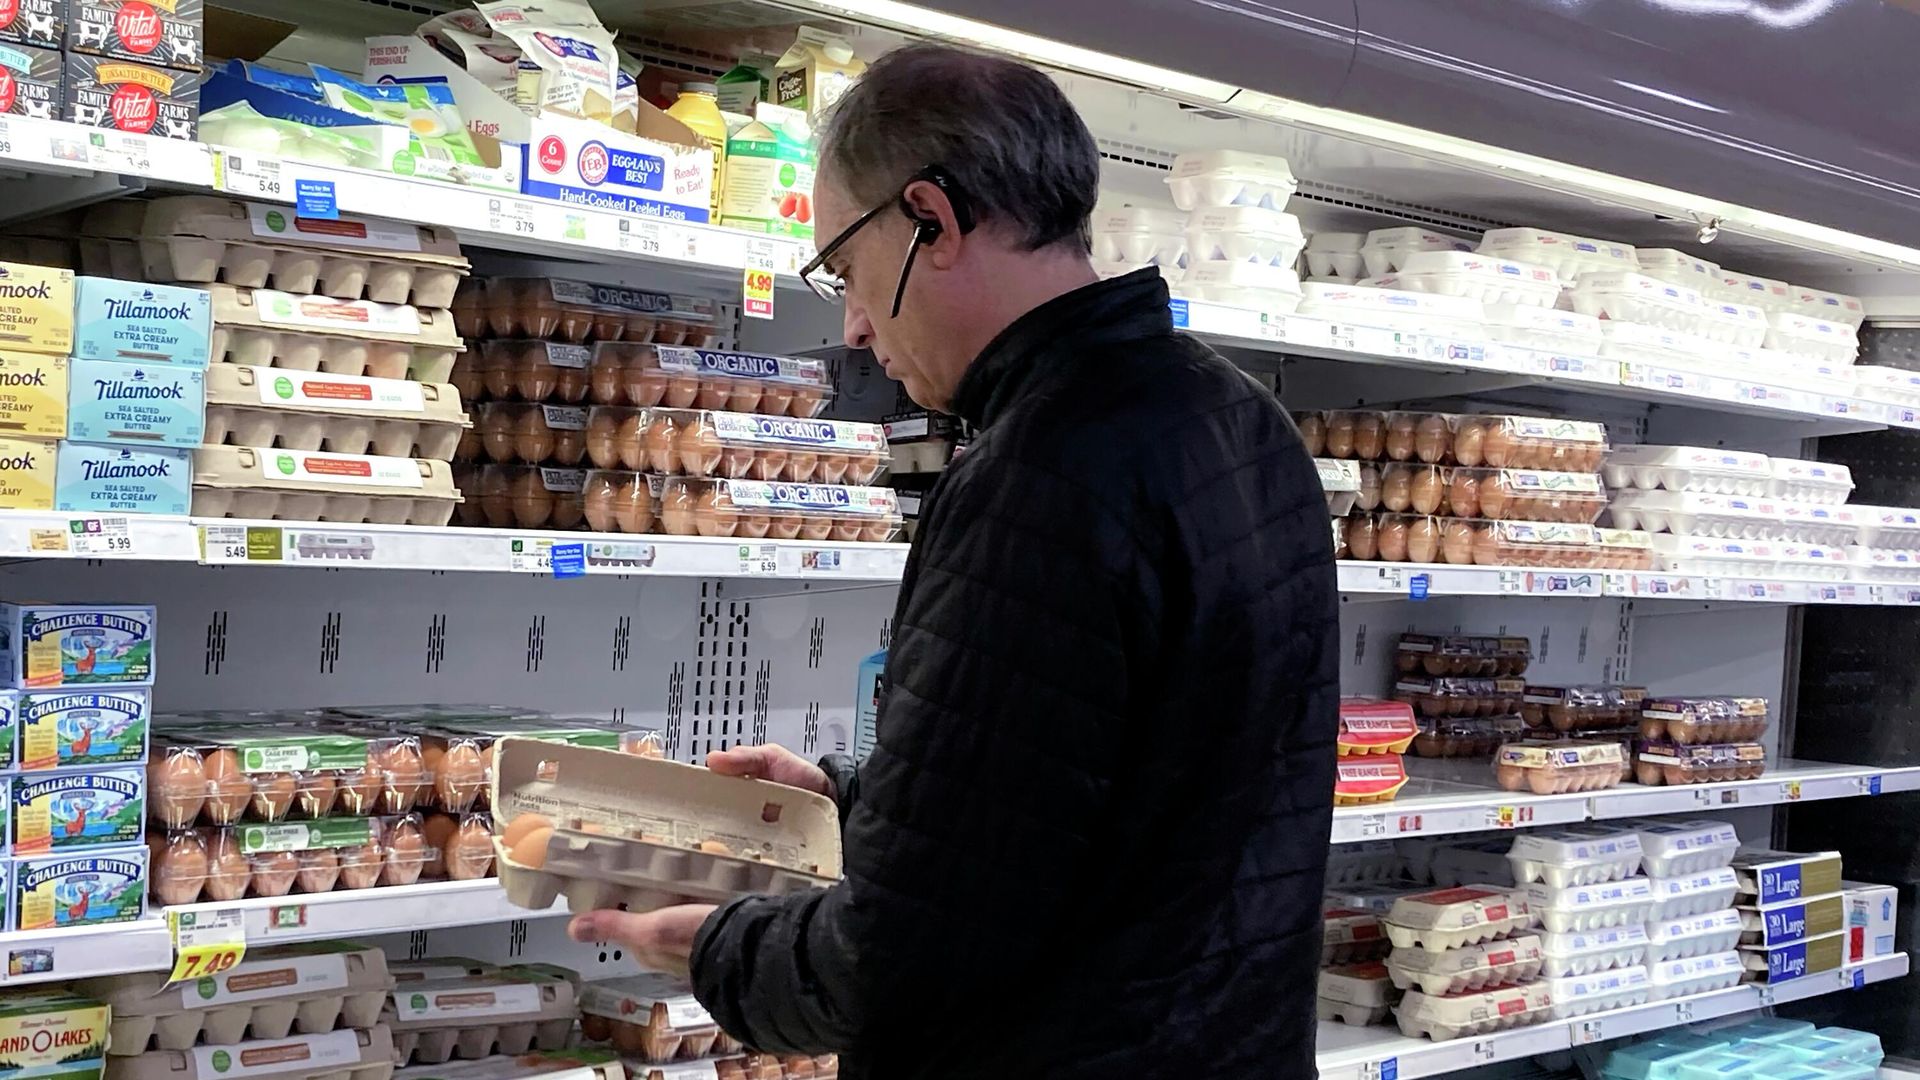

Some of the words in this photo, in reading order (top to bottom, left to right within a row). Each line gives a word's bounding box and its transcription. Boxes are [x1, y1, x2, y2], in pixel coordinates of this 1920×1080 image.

[82, 8, 116, 27] FAMILY
[118, 9, 155, 37] Vital
[163, 23, 194, 38] FARMS
[17, 83, 50, 100] FARMS
[78, 91, 112, 108] FAMILY
[781, 88, 801, 102] Free
[113, 92, 151, 120] Vital
[159, 104, 190, 120] FARMS
[475, 120, 500, 136] Eggs
[549, 142, 557, 155] 6
[541, 156, 562, 167] Count
[588, 156, 602, 171] EB
[625, 170, 649, 184] BEST
[674, 165, 700, 180] Ready
[259, 181, 281, 194] 5.49
[676, 185, 686, 195] to
[688, 179, 704, 193] Eat!
[559, 188, 626, 211] Hard-Cooked
[629, 200, 661, 217] Peeled
[663, 206, 686, 221] Eggs
[516, 221, 535, 233] 3.79
[643, 240, 660, 251] 3.79
[747, 273, 772, 291] 4.99
[598, 288, 669, 310] ORGANIC
[104, 298, 191, 320] Tillamook
[127, 324, 140, 332] SEA
[142, 326, 167, 334] SALTED
[114, 332, 141, 341] EXTRA
[143, 334, 179, 345] CREAMY
[132, 343, 159, 351] BUTTER
[705, 354, 775, 374] ORGANIC
[94, 379, 183, 400] Tillamook
[118, 405, 132, 413] SEA
[133, 406, 160, 414] SALTED
[104, 412, 132, 421] EXTRA
[134, 414, 172, 424] CREAMY
[124, 422, 151, 430] BUTTER
[761, 420, 832, 440] ORGANIC
[81, 459, 170, 480] Tillamook
[119, 485, 145, 493] SALTED
[776, 486, 846, 505] ORGANIC
[91, 492, 119, 500] EXTRA
[121, 493, 158, 503] CREAMY
[87, 520, 99, 532] GF
[108, 537, 131, 549] 5.99
[225, 546, 246, 558] 5.49
[32, 614, 98, 635] CHALLENGE
[102, 615, 142, 636] BUTTER
[28, 695, 94, 719] CHALLENGE
[98, 696, 138, 714] BUTTER
[1348, 719, 1367, 729] FREE
[1368, 720, 1391, 729] RANGE
[1341, 768, 1357, 778] FREE
[1358, 768, 1380, 777] RANGE
[21, 776, 88, 800] CHALLENGE
[92, 777, 134, 795] BUTTER
[513, 791, 558, 806] Nutrition
[513, 800, 540, 810] Facts
[27, 860, 92, 886] CHALLENGE
[96, 860, 137, 878] BUTTER
[1764, 874, 1774, 886] 30
[1776, 873, 1800, 896] Large
[1769, 914, 1781, 926] 30
[1782, 914, 1805, 937] Large
[183, 952, 236, 978] 7.49
[1771, 954, 1781, 965] 30
[1783, 952, 1805, 975] Large
[55, 1028, 92, 1047] LAKES
